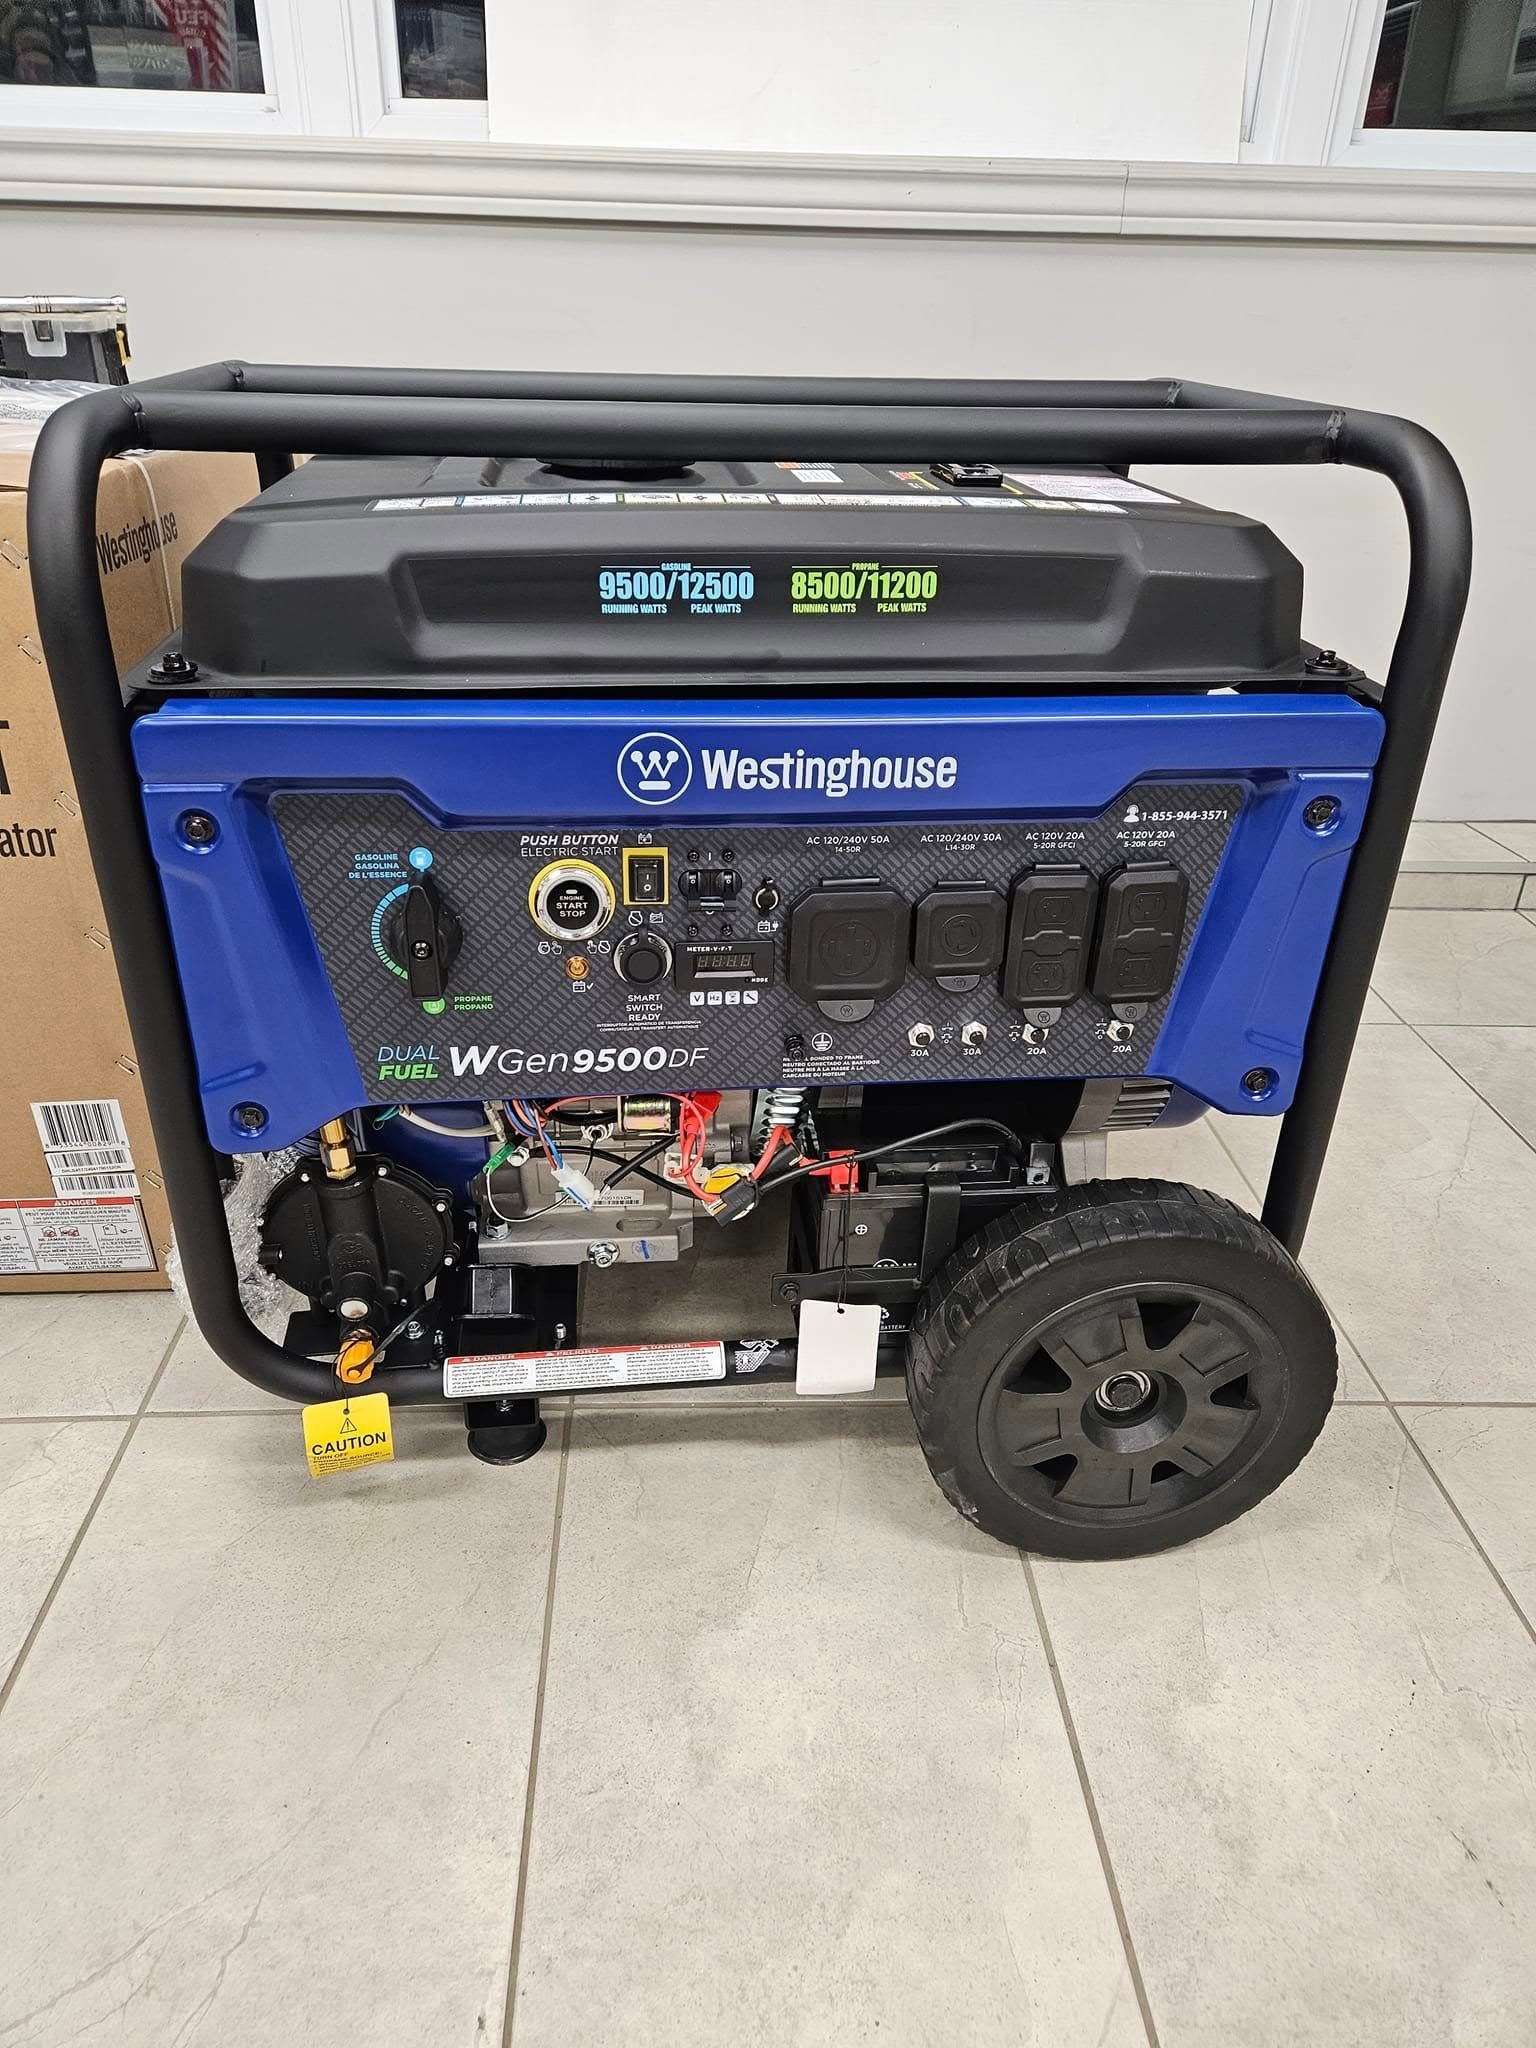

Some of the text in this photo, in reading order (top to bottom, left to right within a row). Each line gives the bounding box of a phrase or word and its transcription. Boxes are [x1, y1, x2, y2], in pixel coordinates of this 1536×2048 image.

[661, 563, 692, 571] GASOLINE
[852, 562, 880, 570] PROPANE
[599, 571, 754, 600] 9500/12500
[791, 571, 938, 599] 8500/11200
[601, 604, 668, 613] RUNNING WATTS
[691, 604, 742, 613] PEAK WATTS
[792, 603, 857, 613] RUNNING WATTS
[877, 603, 927, 612] PEAK WATTS
[701, 749, 958, 798] Westinghouse
[1142, 810, 1228, 821] 1-855-944-3571
[920, 833, 1002, 843] AC 120/240V 30A
[1041, 832, 1064, 840] 120V
[1066, 832, 1085, 840] 20A
[1116, 831, 1176, 839] AC 120V 20A
[520, 834, 619, 846] PUSH BUTTON
[806, 835, 890, 845] AC 120/240V 50A
[1057, 841, 1076, 849] GFCI
[521, 846, 618, 857] ELECTRIC START
[355, 862, 400, 870] GASOLINA
[362, 871, 408, 879] L'ESSENCE
[627, 994, 661, 1002] SMART
[454, 1003, 494, 1011] PROPANO
[626, 1003, 663, 1012] SWITCH
[628, 1013, 662, 1021] READY
[377, 1044, 441, 1062] DUAL
[910, 1049, 929, 1057] 30A
[963, 1048, 982, 1056] 30A
[1027, 1047, 1047, 1055] 20A
[1112, 1045, 1132, 1053] 20A
[378, 1063, 440, 1081] FUEL
[473, 1354, 515, 1362] DANGER
[311, 1431, 386, 1456] CAUTION
